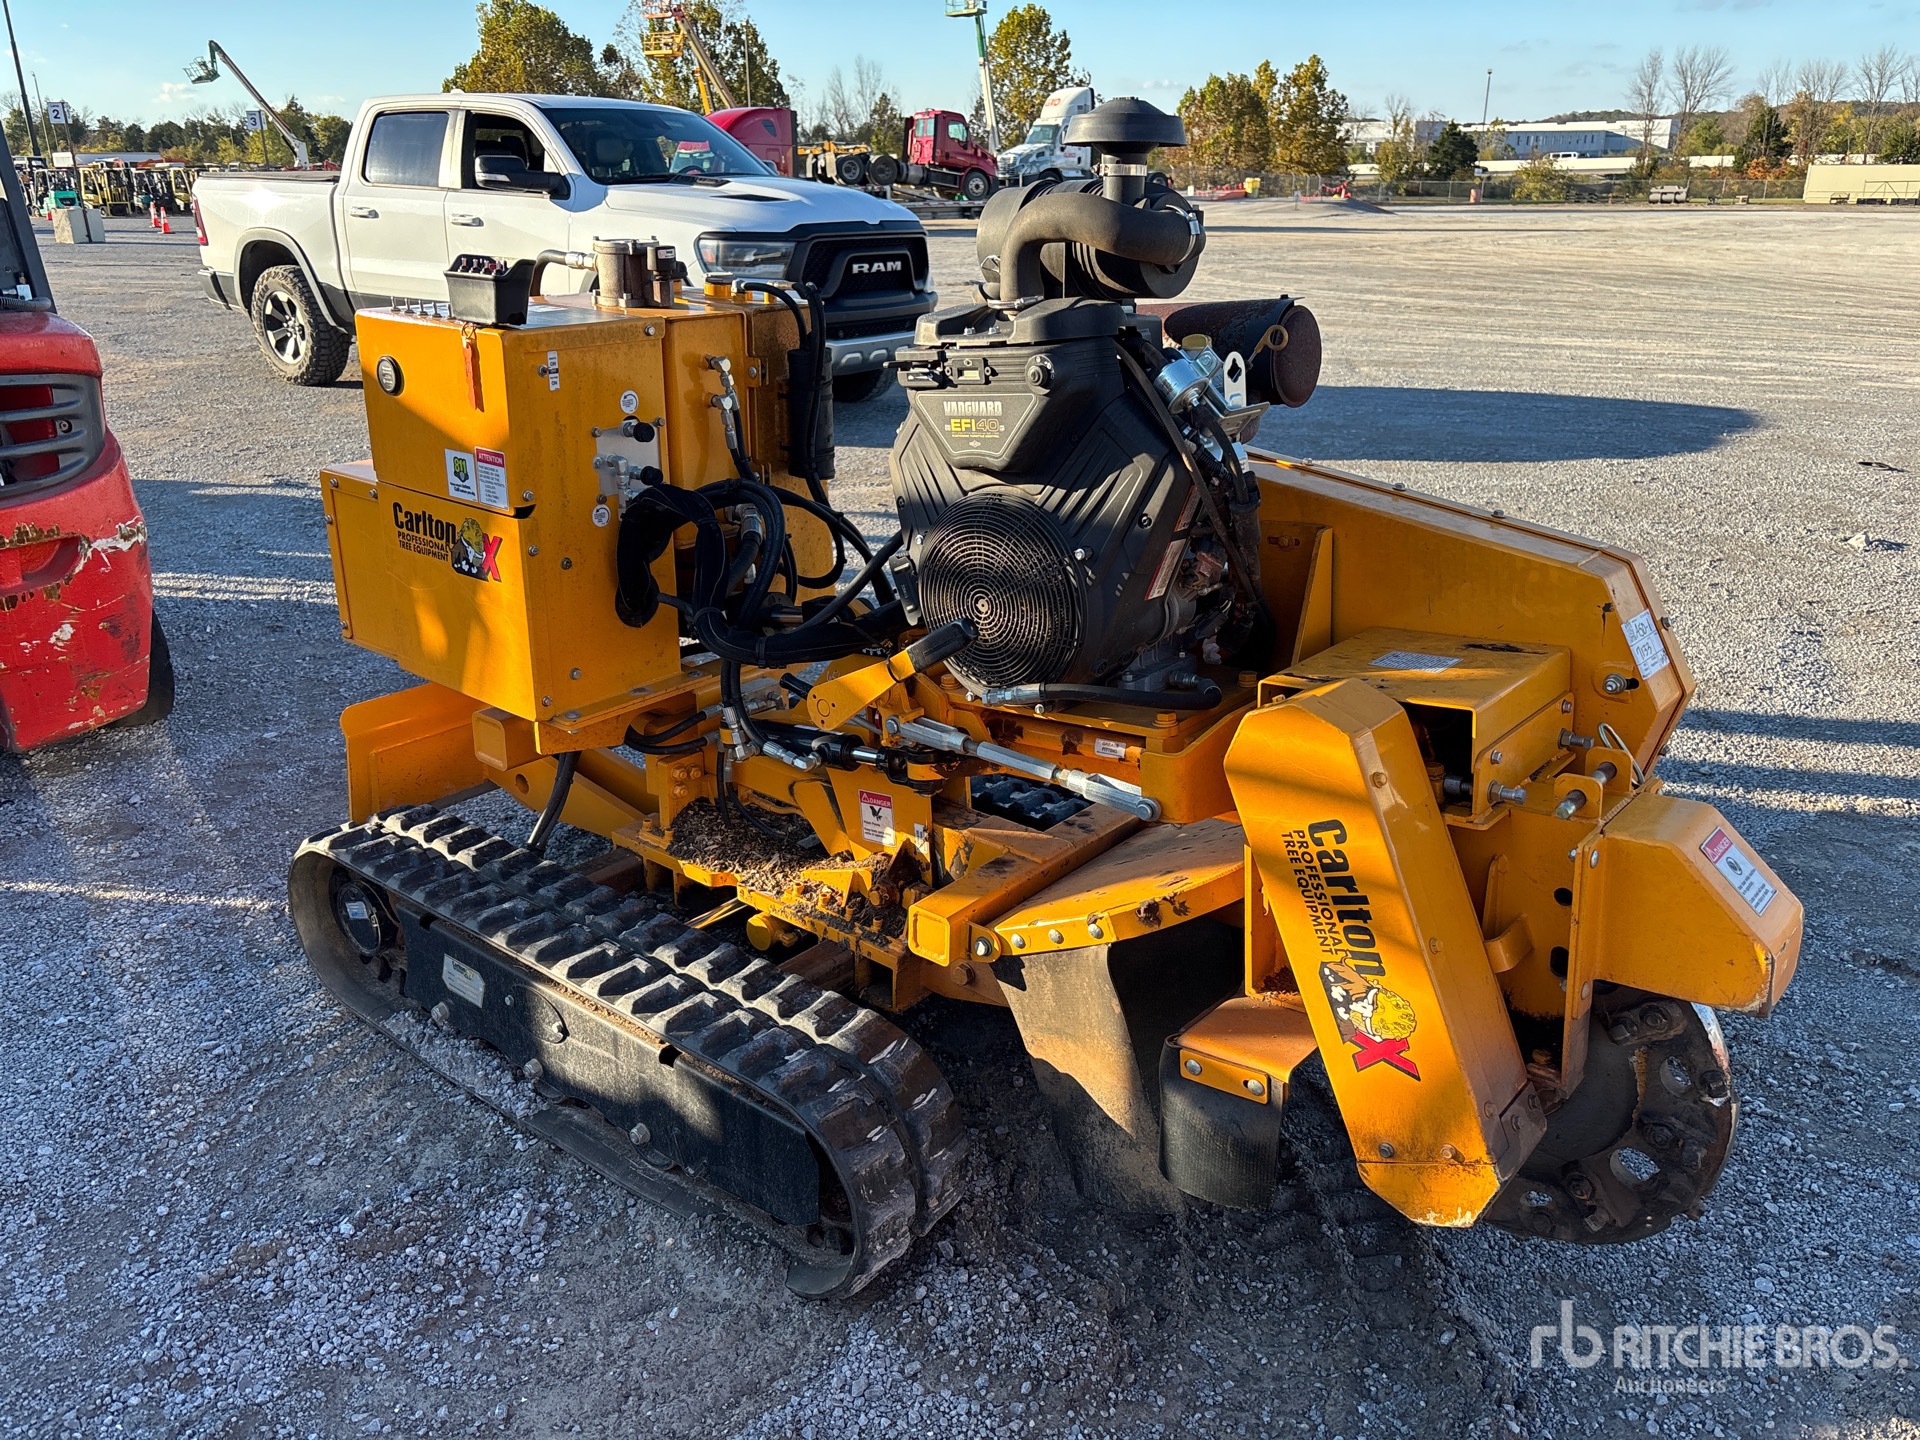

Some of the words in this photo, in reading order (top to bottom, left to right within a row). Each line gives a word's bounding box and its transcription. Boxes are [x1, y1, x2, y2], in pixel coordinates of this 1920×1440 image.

[52, 109, 60, 119] 2
[250, 117, 257, 126] 3
[852, 261, 901, 274] RAM
[943, 401, 1002, 416] VANGUARD
[950, 418, 976, 432] EFI
[976, 418, 999, 432] 40
[453, 457, 467, 474] 811
[478, 453, 503, 464] ATTENTION
[393, 502, 457, 545] Carlton
[397, 531, 449, 554] PROFESSIONAL
[399, 540, 412, 551] TREE
[413, 542, 449, 562] EQUIPMENT
[870, 799, 891, 807] DANGER
[1713, 836, 1730, 856] DANGER
[1281, 832, 1302, 865] TREE
[1293, 868, 1337, 955] EQUIPMENT
[1293, 829, 1351, 959] PROFESSIONAL
[1308, 819, 1386, 977] Carlton
